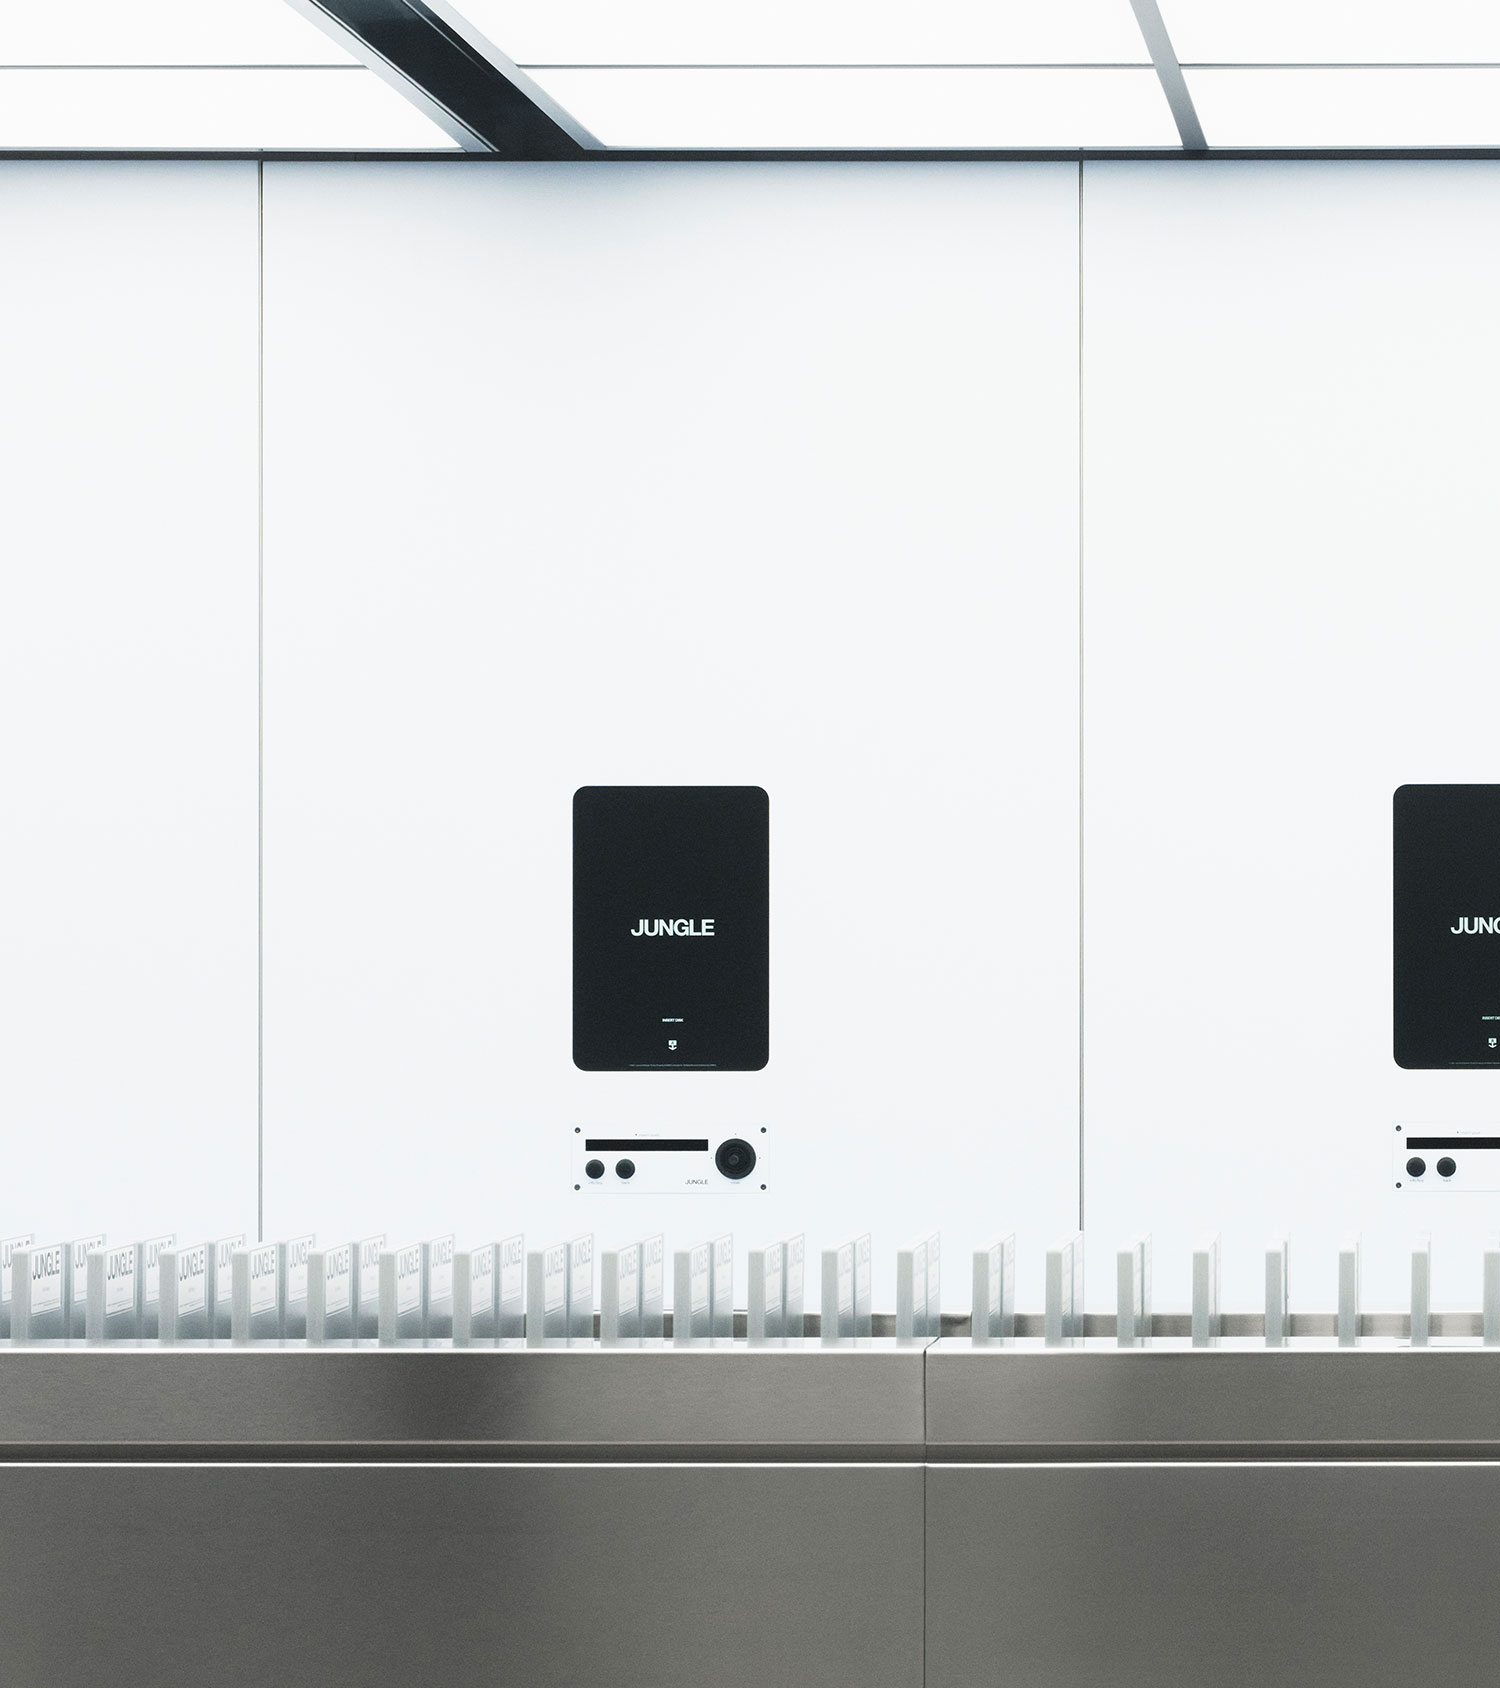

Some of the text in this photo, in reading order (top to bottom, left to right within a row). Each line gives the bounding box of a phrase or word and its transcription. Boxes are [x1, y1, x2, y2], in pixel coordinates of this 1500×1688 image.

[630, 918, 715, 937] JUNGLE
[32, 1250, 60, 1280] JUNGLE
[74, 1240, 102, 1269] JUN
[107, 1250, 133, 1280] JUNGLE
[146, 1240, 172, 1269] JUN
[179, 1250, 204, 1281] JUNGLE
[251, 1250, 275, 1280] JUNGLE
[326, 1249, 348, 1280] JUNGLE
[398, 1249, 419, 1280] JUNGLE
[431, 1240, 452, 1269] JUNGLE
[472, 1250, 491, 1280] JUNGLE
[502, 1240, 521, 1269] JUNGLE
[545, 1249, 563, 1279] JUNGLE
[573, 1239, 591, 1269] JUNGLE
